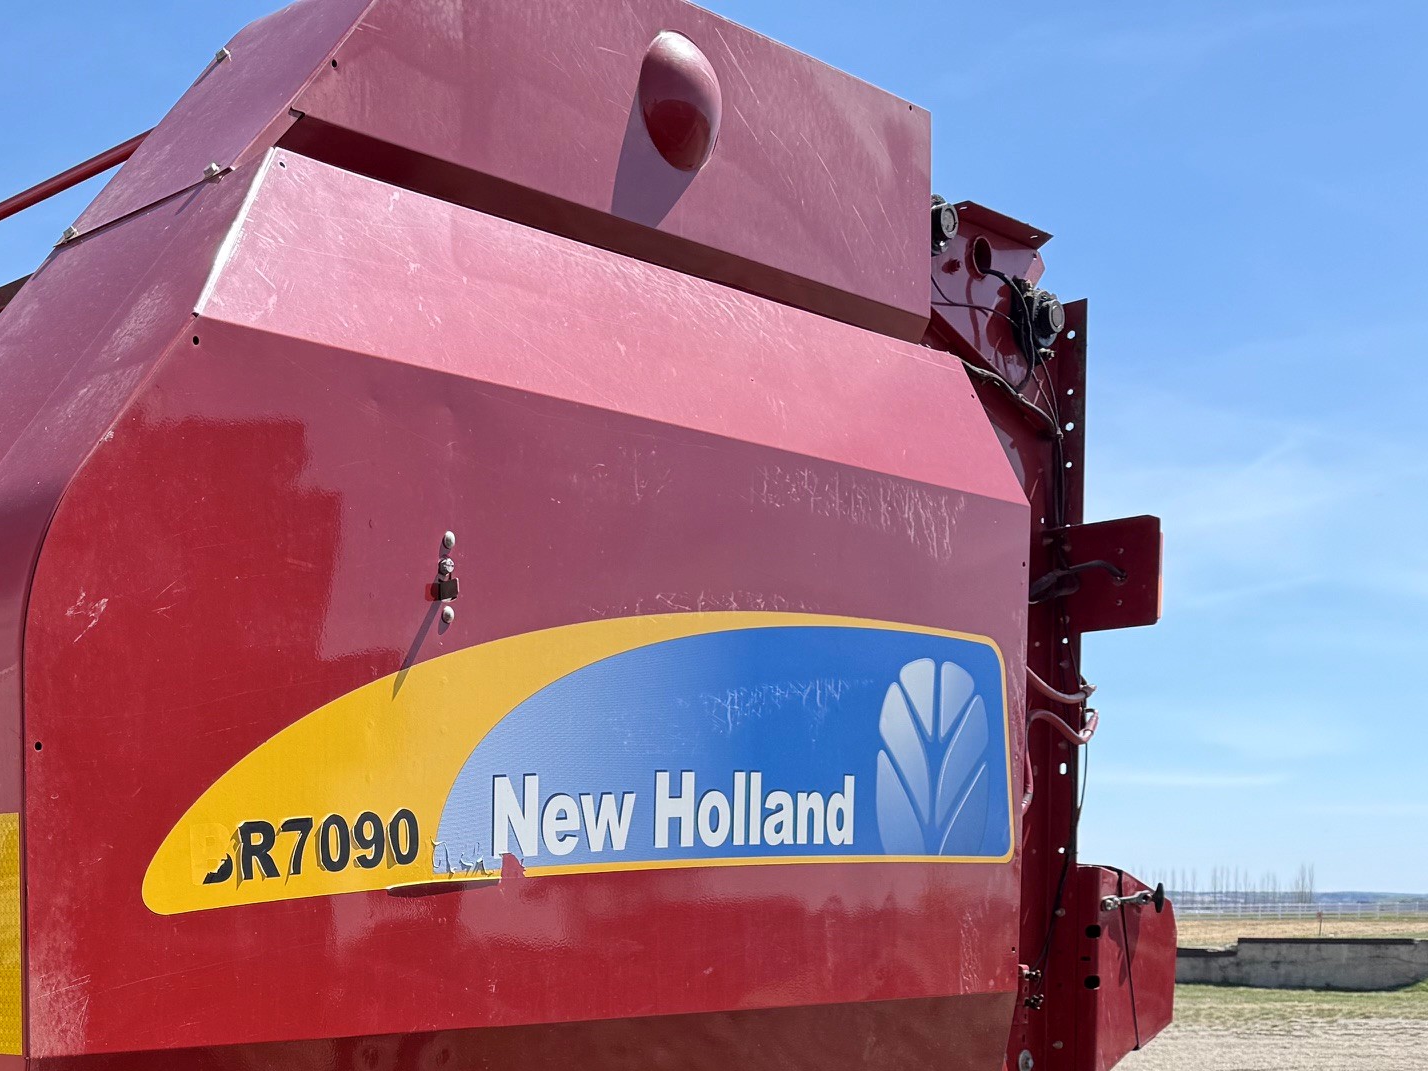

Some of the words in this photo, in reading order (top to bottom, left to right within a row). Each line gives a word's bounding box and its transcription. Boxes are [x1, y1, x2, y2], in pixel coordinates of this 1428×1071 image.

[190, 808, 419, 885] R7090
[492, 772, 637, 859] New
[653, 770, 855, 849] Holland
